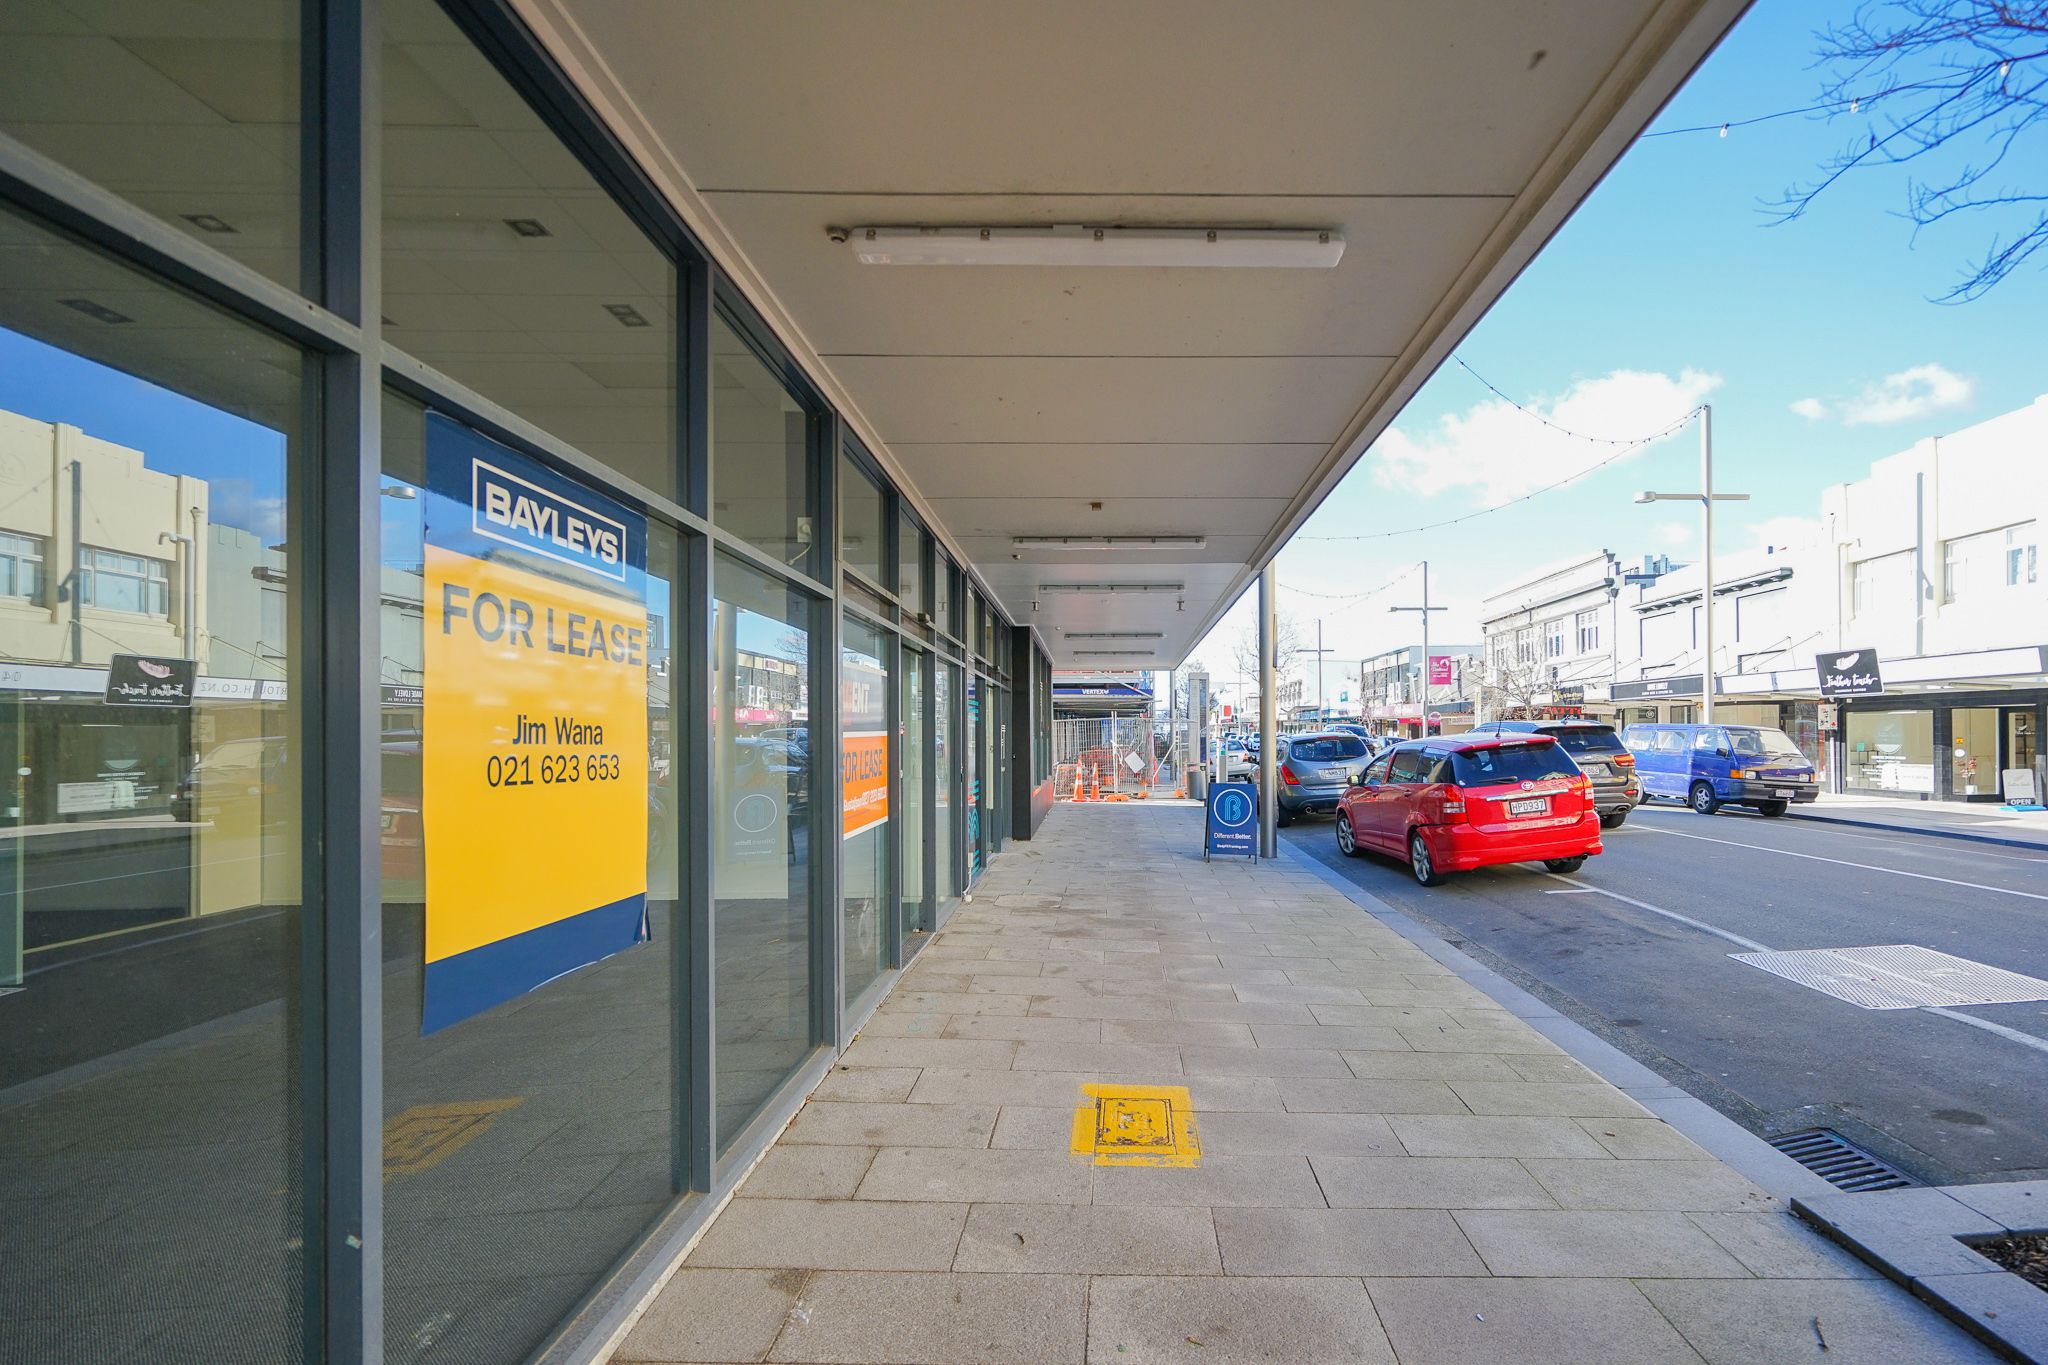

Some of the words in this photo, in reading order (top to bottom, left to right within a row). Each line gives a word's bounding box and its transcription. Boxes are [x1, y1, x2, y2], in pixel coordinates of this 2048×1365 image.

[486, 482, 619, 565] BAYLEYS
[443, 582, 534, 648] FOR
[547, 607, 642, 666] LEASE
[512, 714, 546, 745] Jim
[555, 716, 603, 745] Wana
[487, 755, 534, 787] 021
[541, 754, 580, 784] 623
[586, 754, 620, 781] 653
[860, 749, 883, 780] LEASE
[1512, 800, 1544, 813] HPD937
[2010, 798, 2032, 806] OPEN
